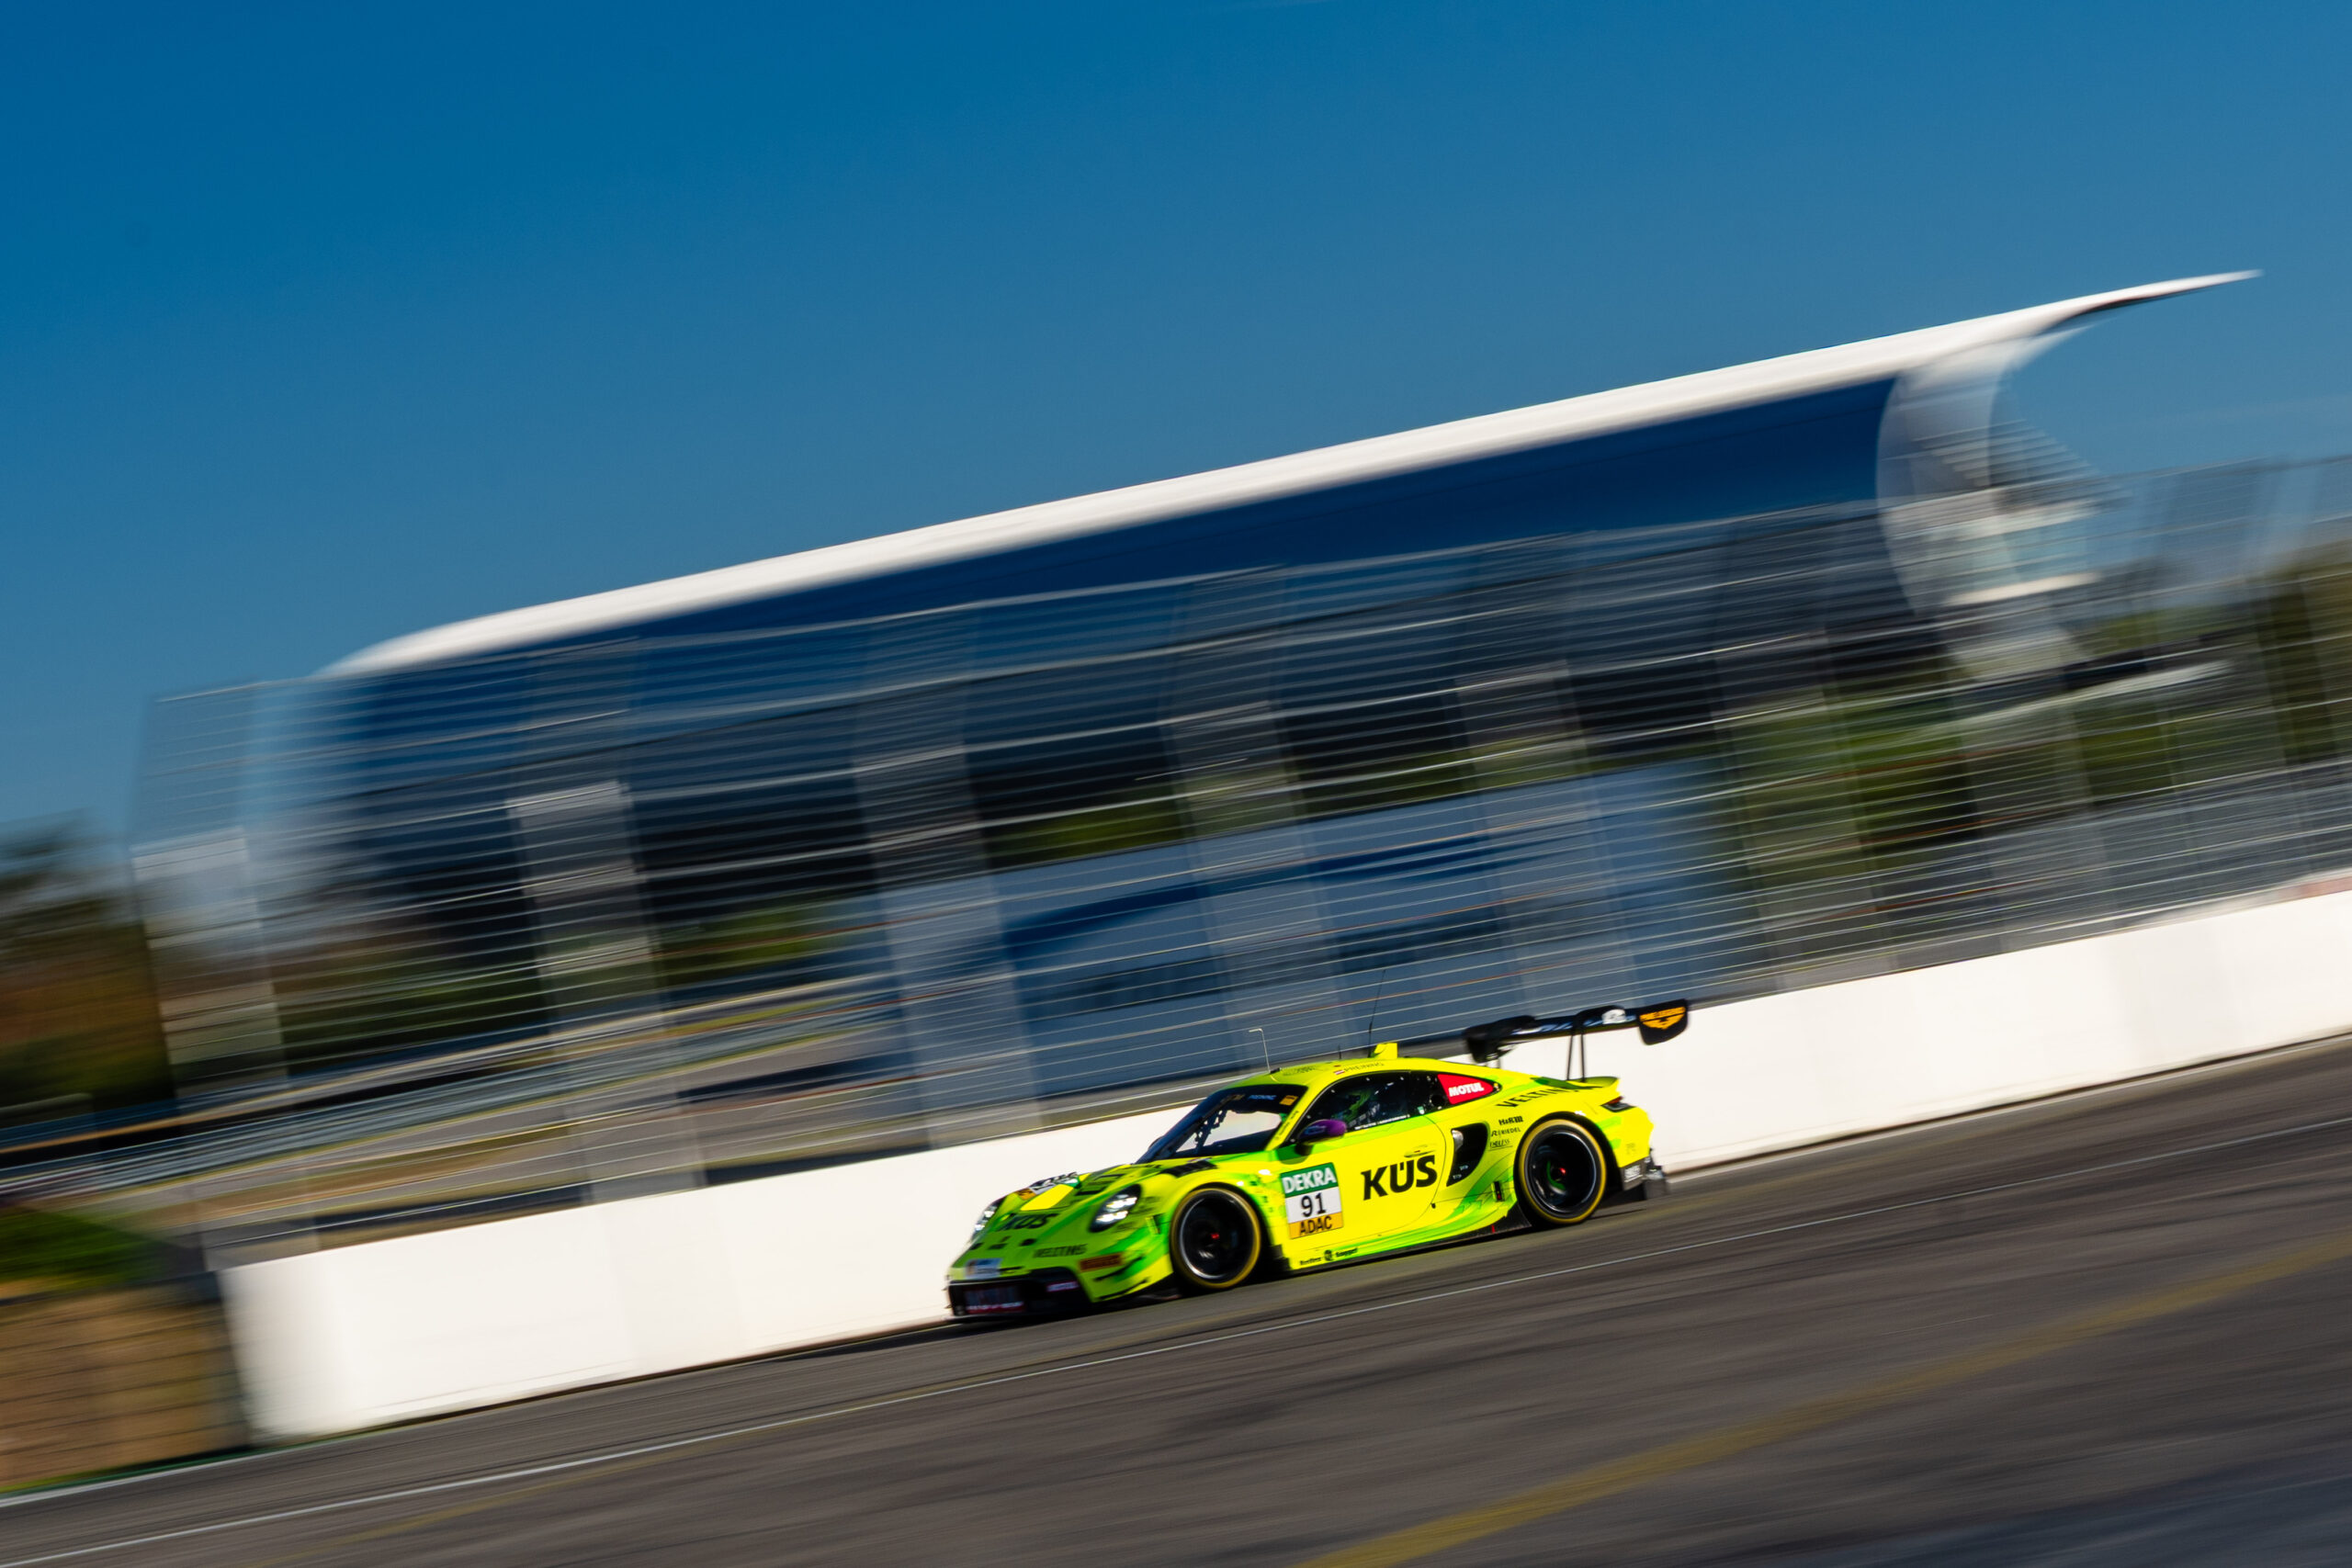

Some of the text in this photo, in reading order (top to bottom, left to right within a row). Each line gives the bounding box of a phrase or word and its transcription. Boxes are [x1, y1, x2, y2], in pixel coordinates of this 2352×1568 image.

[1448, 1082, 1485, 1097] MOTUL
[1282, 1168, 1337, 1194] DEKRA
[1361, 1155, 1438, 1201] KÜS
[1301, 1192, 1326, 1217] 91
[1299, 1215, 1332, 1235] ADAC
